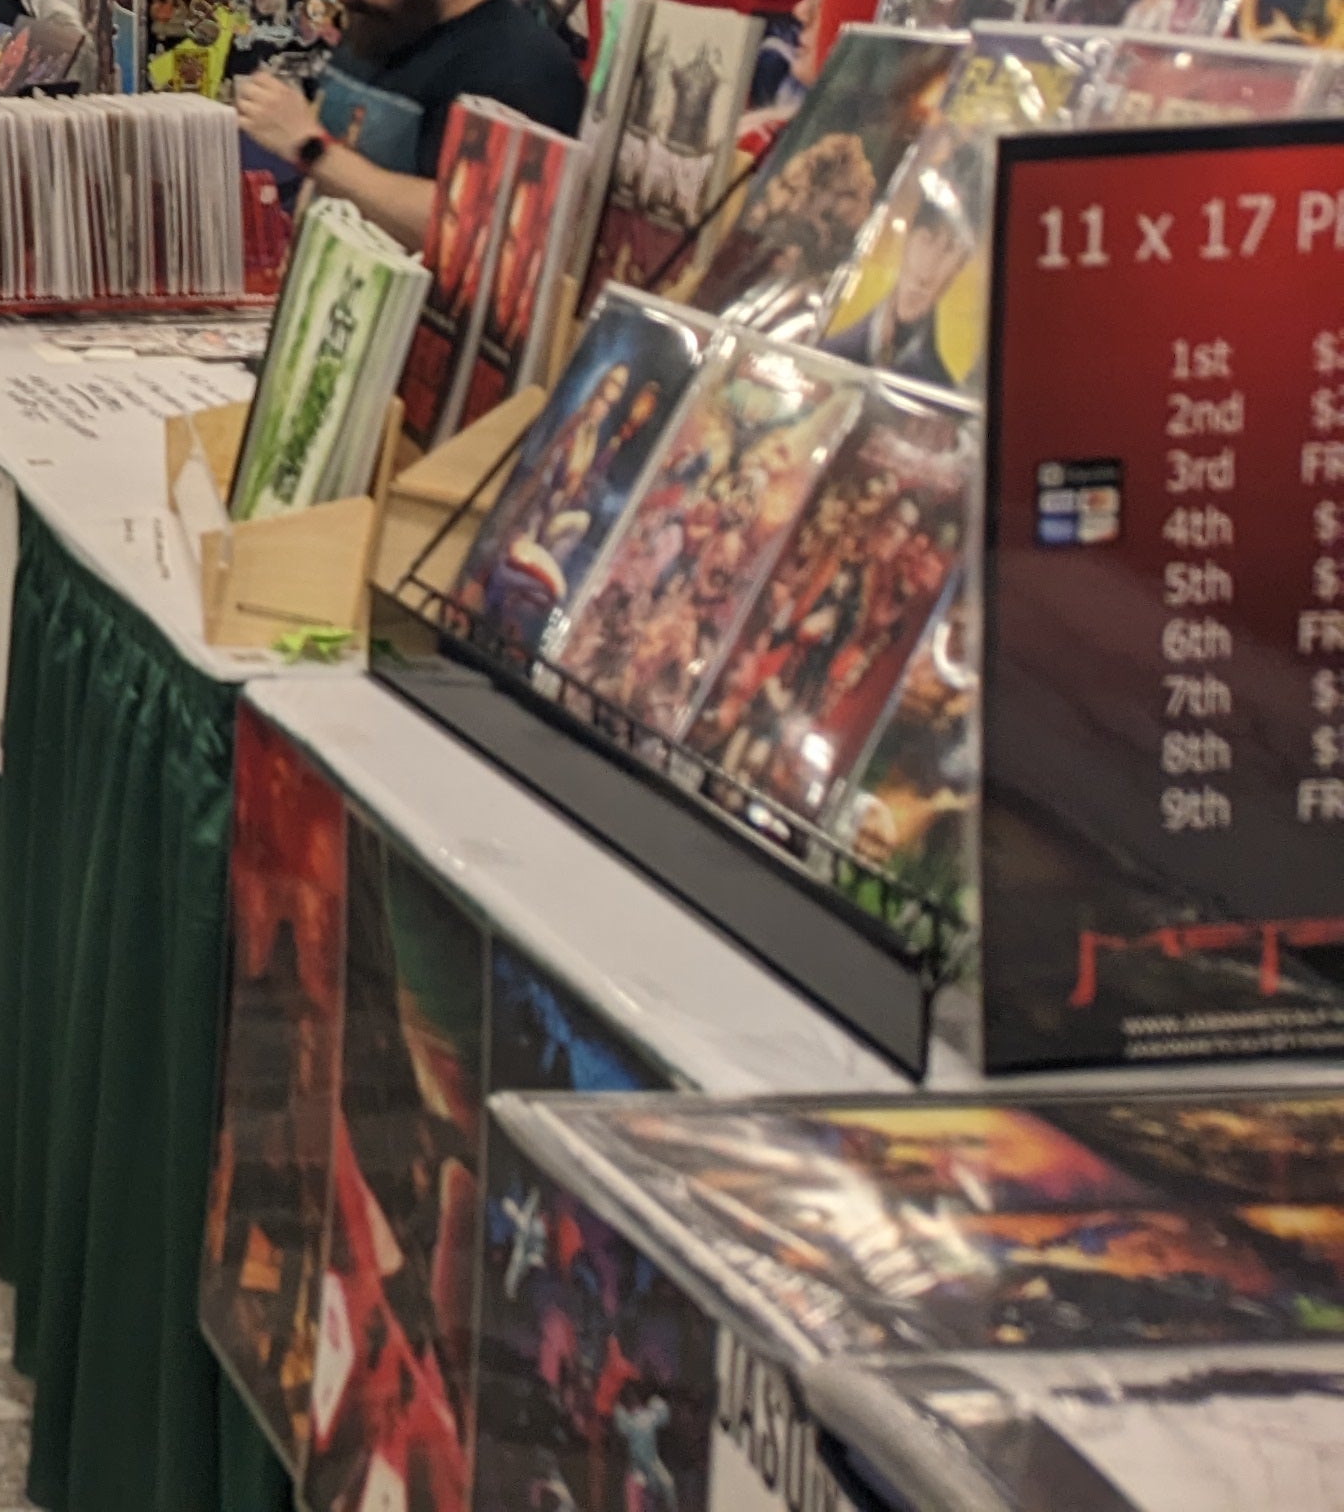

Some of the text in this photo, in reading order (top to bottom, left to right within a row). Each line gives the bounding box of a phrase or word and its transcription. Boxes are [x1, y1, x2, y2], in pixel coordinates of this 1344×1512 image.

[1037, 204, 1110, 268] 11
[1134, 212, 1174, 262] x
[1200, 191, 1276, 259] 17
[1171, 337, 1233, 380] 1st
[1165, 390, 1245, 436] 2nd
[1166, 445, 1236, 494] 3rd
[1162, 503, 1234, 549] 4th
[1163, 559, 1233, 608] 5th
[1162, 615, 1232, 664] 6th
[1162, 672, 1231, 718] 7th
[1162, 727, 1231, 775] 8th
[1160, 785, 1231, 832] 9th
